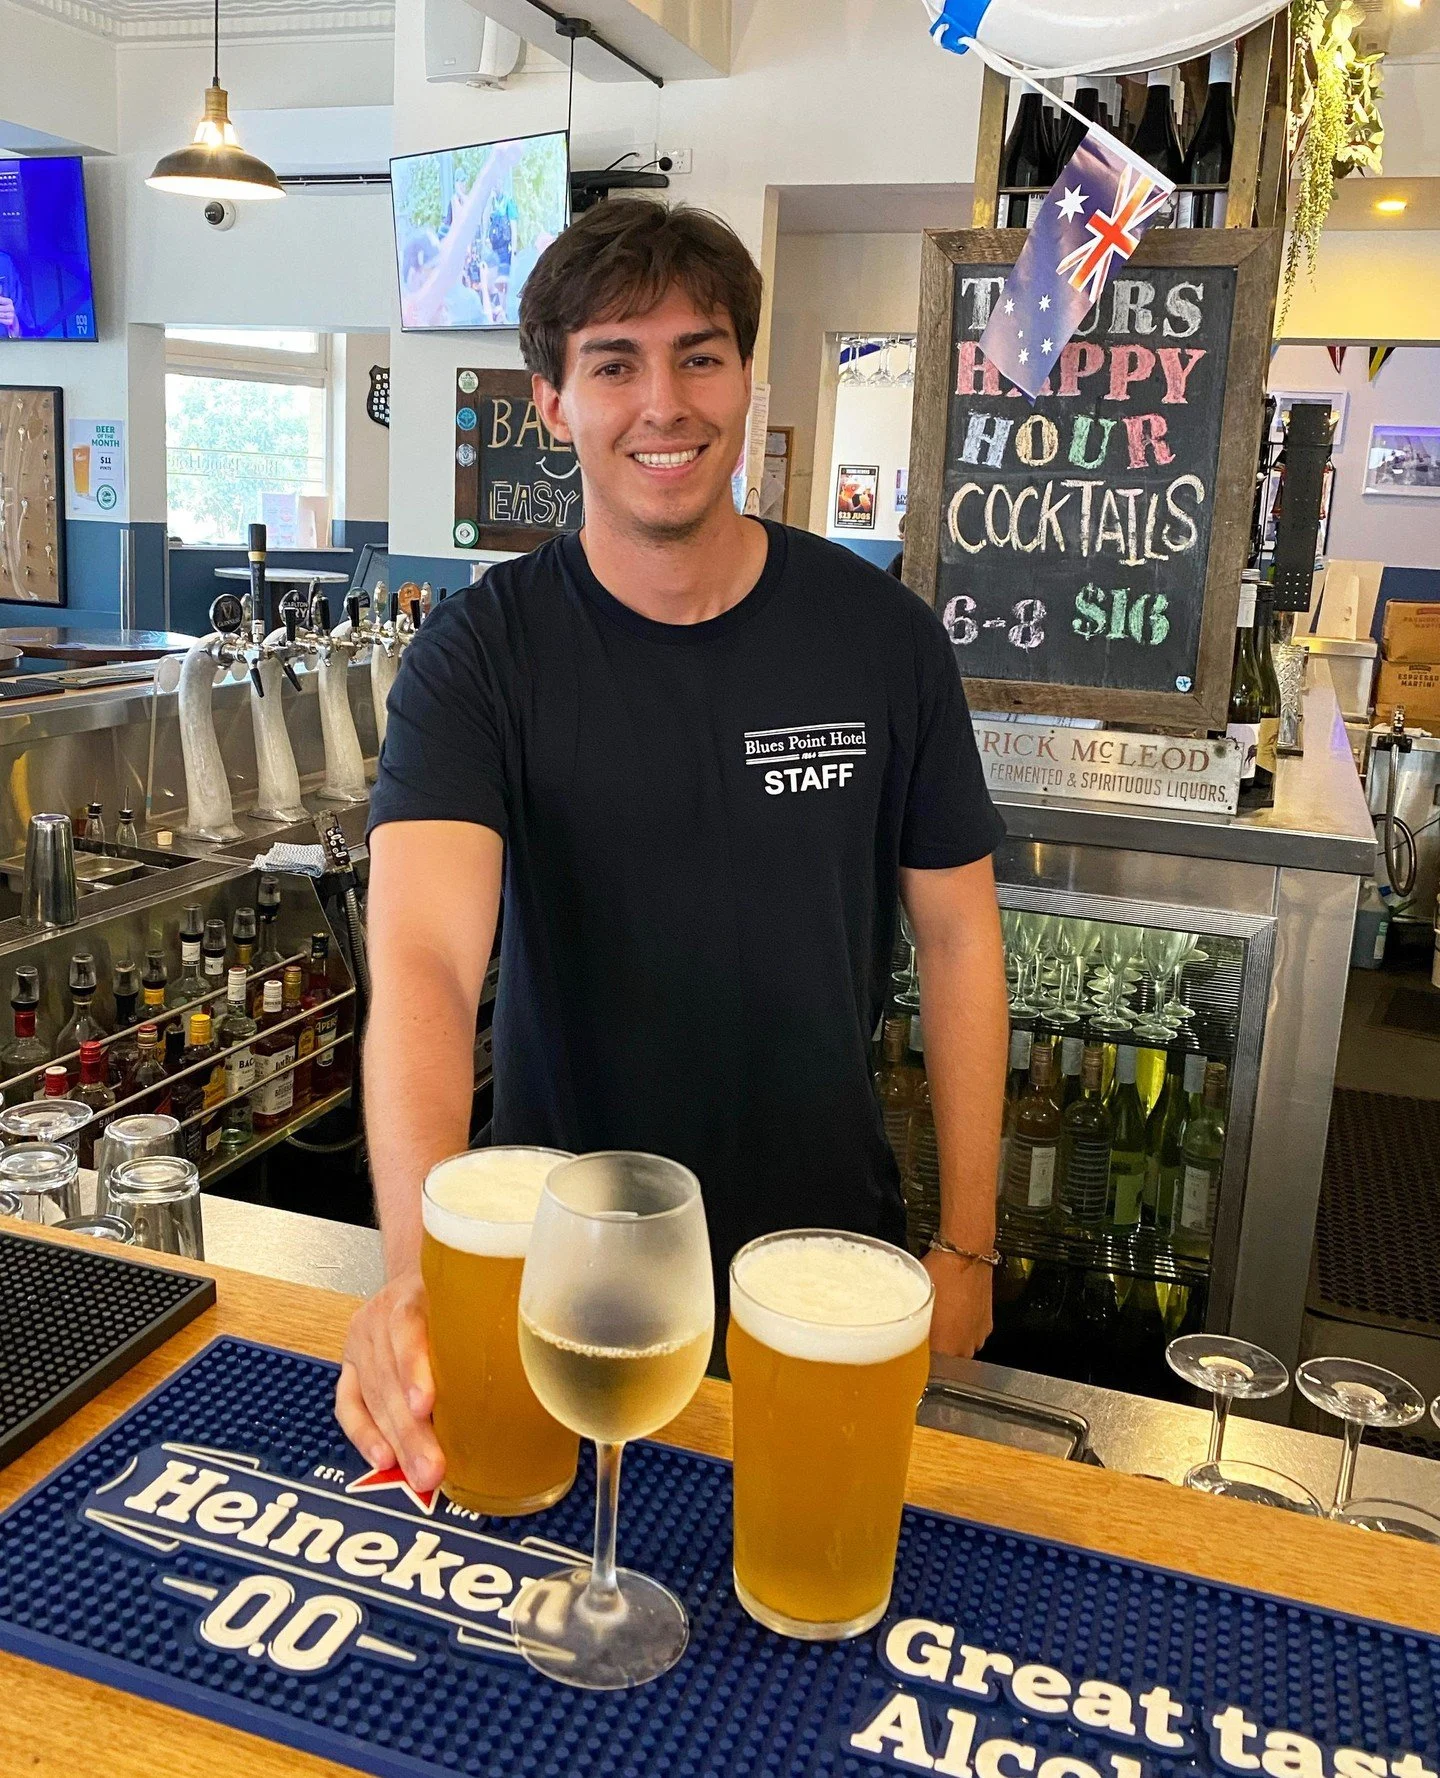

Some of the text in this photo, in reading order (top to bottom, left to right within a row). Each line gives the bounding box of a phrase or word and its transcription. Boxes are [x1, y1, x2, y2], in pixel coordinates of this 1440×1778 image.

[961, 276, 1204, 337] TRS
[955, 341, 1207, 404] HPPY
[91, 439, 120, 447] MONTH
[96, 425, 115, 433] BEER
[957, 410, 1176, 470] HOUR
[100, 456, 111, 464] $11
[489, 481, 581, 527] EASY
[947, 474, 1205, 566] COCKTAILS
[943, 584, 1170, 652] 6-8 $16
[1397, 673, 1439, 681] ESPRESSO
[1401, 680, 1435, 688] MARTINI
[744, 731, 867, 755] Blues Point Hotel
[975, 730, 1058, 761] RICK
[764, 763, 854, 796] STAFF
[990, 762, 1228, 803] FERMENTED & SPIRITUOUS LIQUORS.
[313, 1465, 345, 1484] EST.
[124, 1460, 574, 1632] Heineken
[200, 1575, 363, 1672] 0.0
[885, 1617, 1184, 1748] Great
